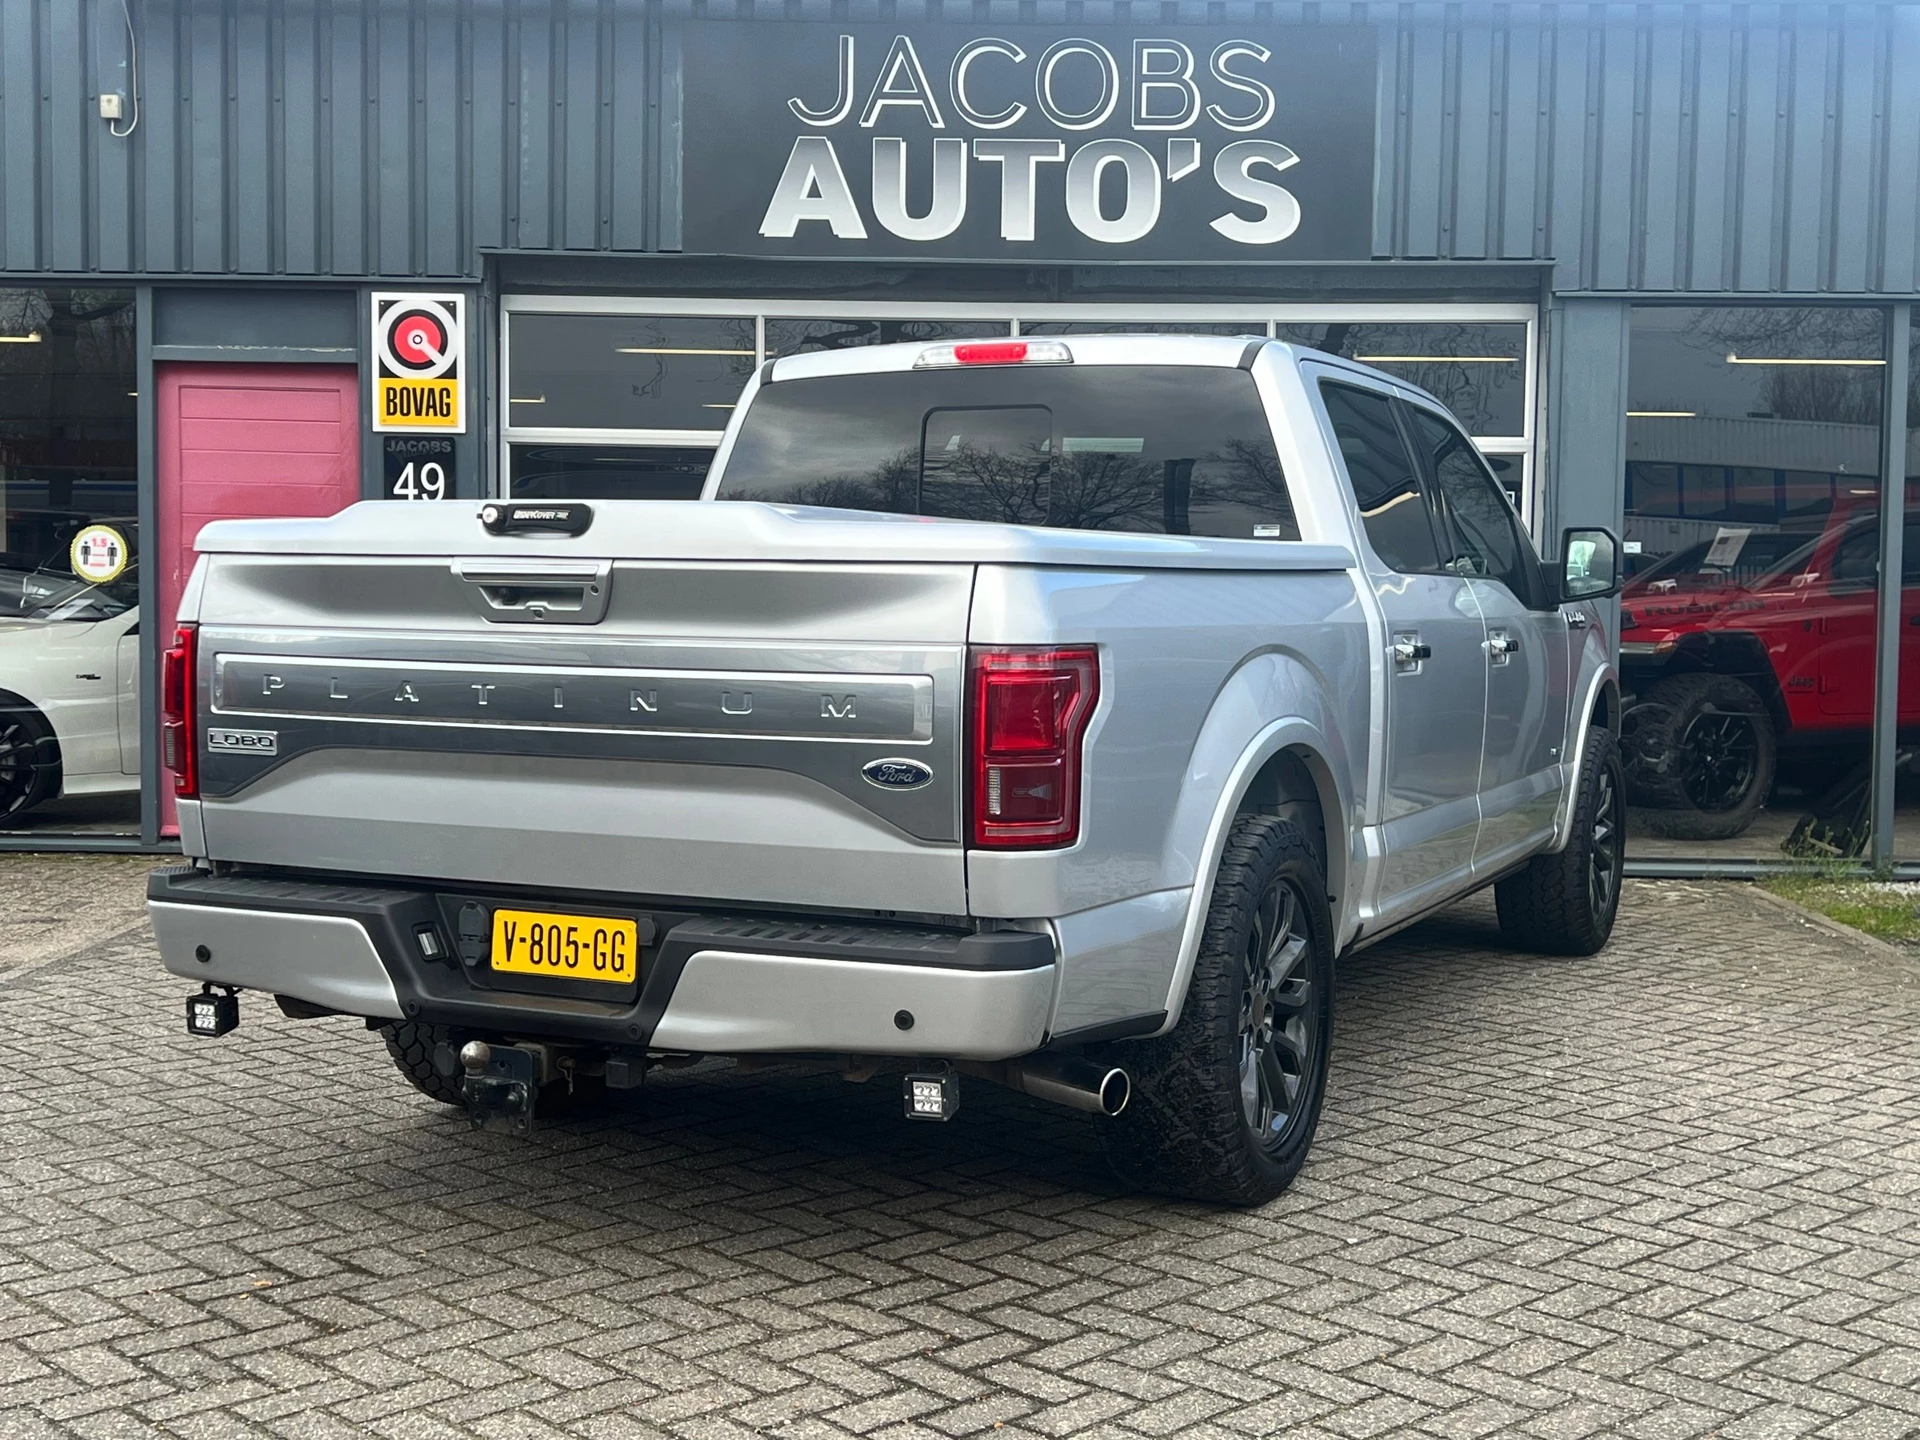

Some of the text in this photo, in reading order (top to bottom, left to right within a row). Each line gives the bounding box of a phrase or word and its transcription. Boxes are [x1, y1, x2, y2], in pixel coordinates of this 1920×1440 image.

[787, 34, 1276, 132] JACOBS
[759, 135, 1301, 245] AUTO'S
[385, 386, 452, 418] BOVAG
[386, 440, 452, 453] JACOBS
[393, 461, 445, 500] 49
[91, 537, 108, 548] 1.5
[1644, 600, 1767, 617] RUBICON
[262, 673, 857, 719] PLATINUM
[209, 732, 275, 748] LOBO
[876, 762, 917, 783] Ford
[503, 920, 626, 973] V-805-GG
